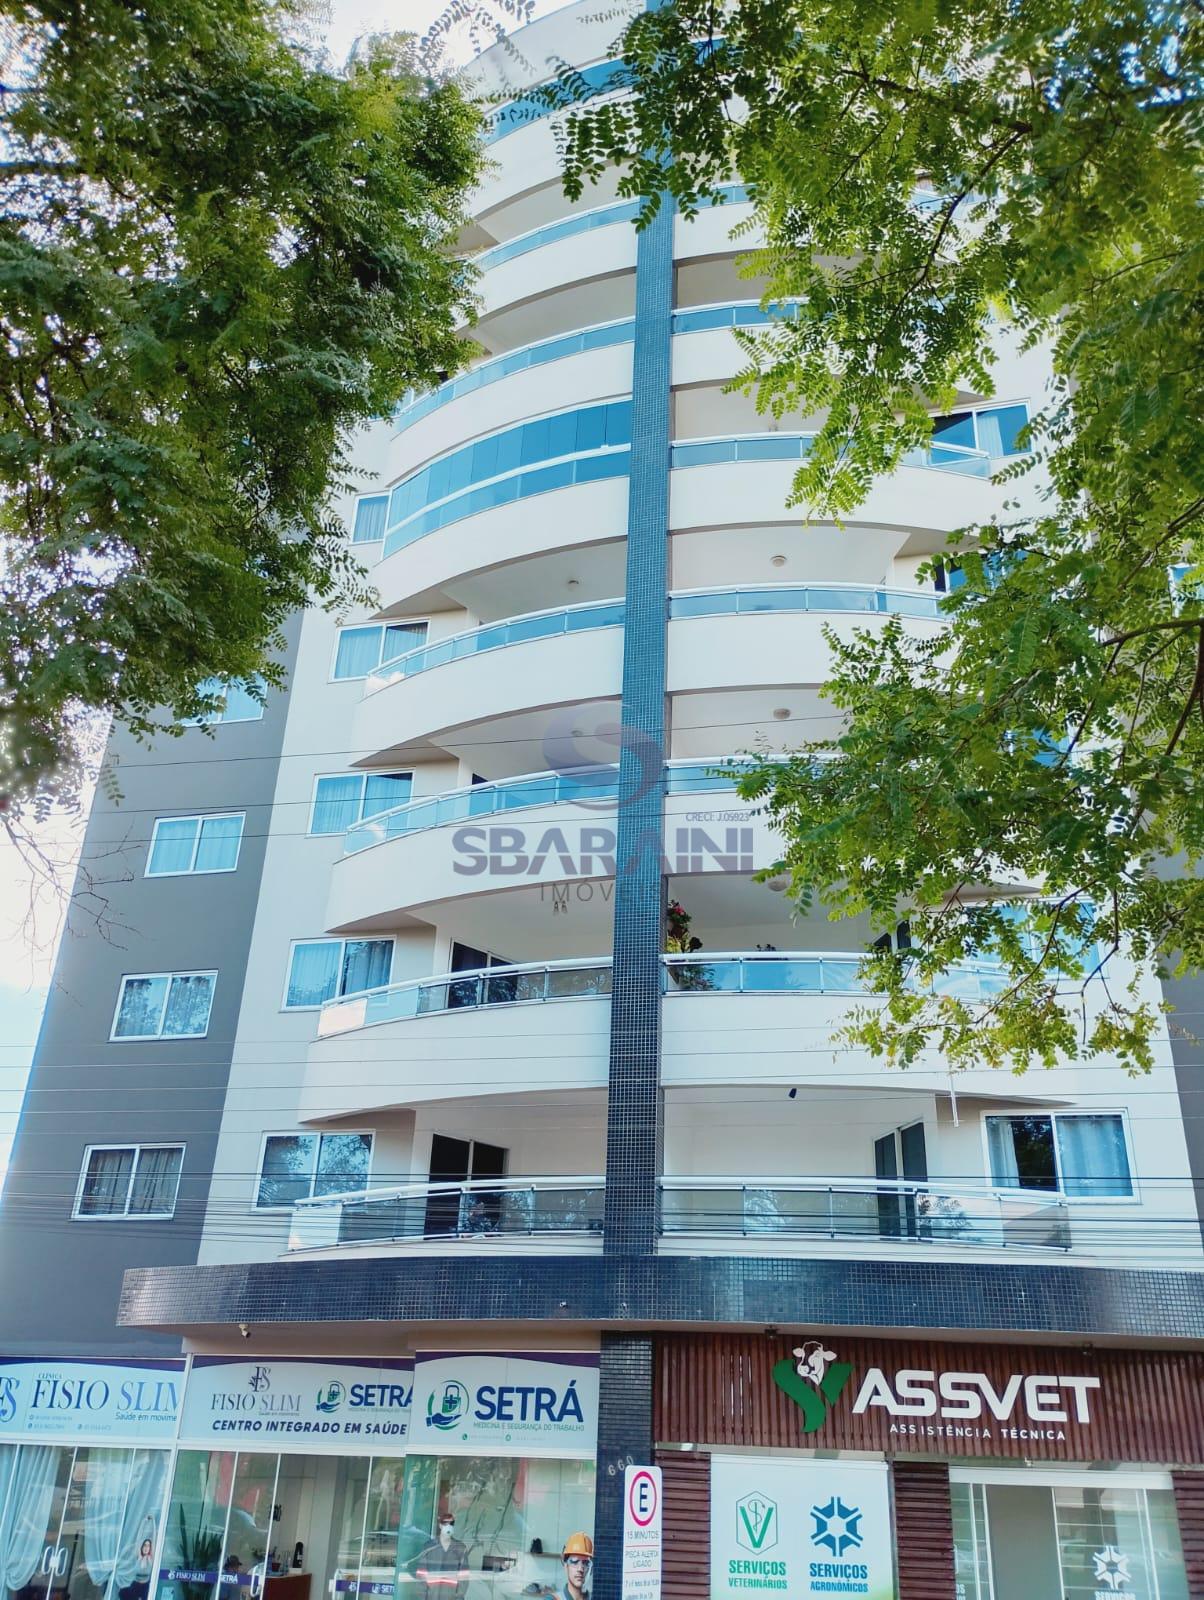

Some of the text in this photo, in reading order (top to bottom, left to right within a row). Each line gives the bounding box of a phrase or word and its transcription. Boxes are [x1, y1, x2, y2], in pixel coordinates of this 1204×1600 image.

[31, 1379, 110, 1410] FISIO
[211, 1393, 302, 1412] FISIO SLIM
[474, 1379, 584, 1423] SETRÁ
[852, 1367, 1101, 1424] ASSVET
[115, 1411, 136, 1420] Saúde
[212, 1420, 407, 1435] CENTRO INTEGRADO EM SAÚDE
[473, 1422, 500, 1430] MEDICINA
[507, 1423, 542, 1431] SEGURANÇA
[553, 1424, 585, 1432] TRABALHO
[890, 1423, 1066, 1440] ASSISTÊNCIA TÉCNICA
[639, 1483, 649, 1513] E
[634, 1530, 660, 1539] MINUTOS
[728, 1559, 787, 1578] SERVIÇOS
[809, 1562, 868, 1581] SERVIÇOS
[728, 1576, 788, 1590] VETERINÁRIOS
[810, 1580, 869, 1593] AGRONÔMICOS
